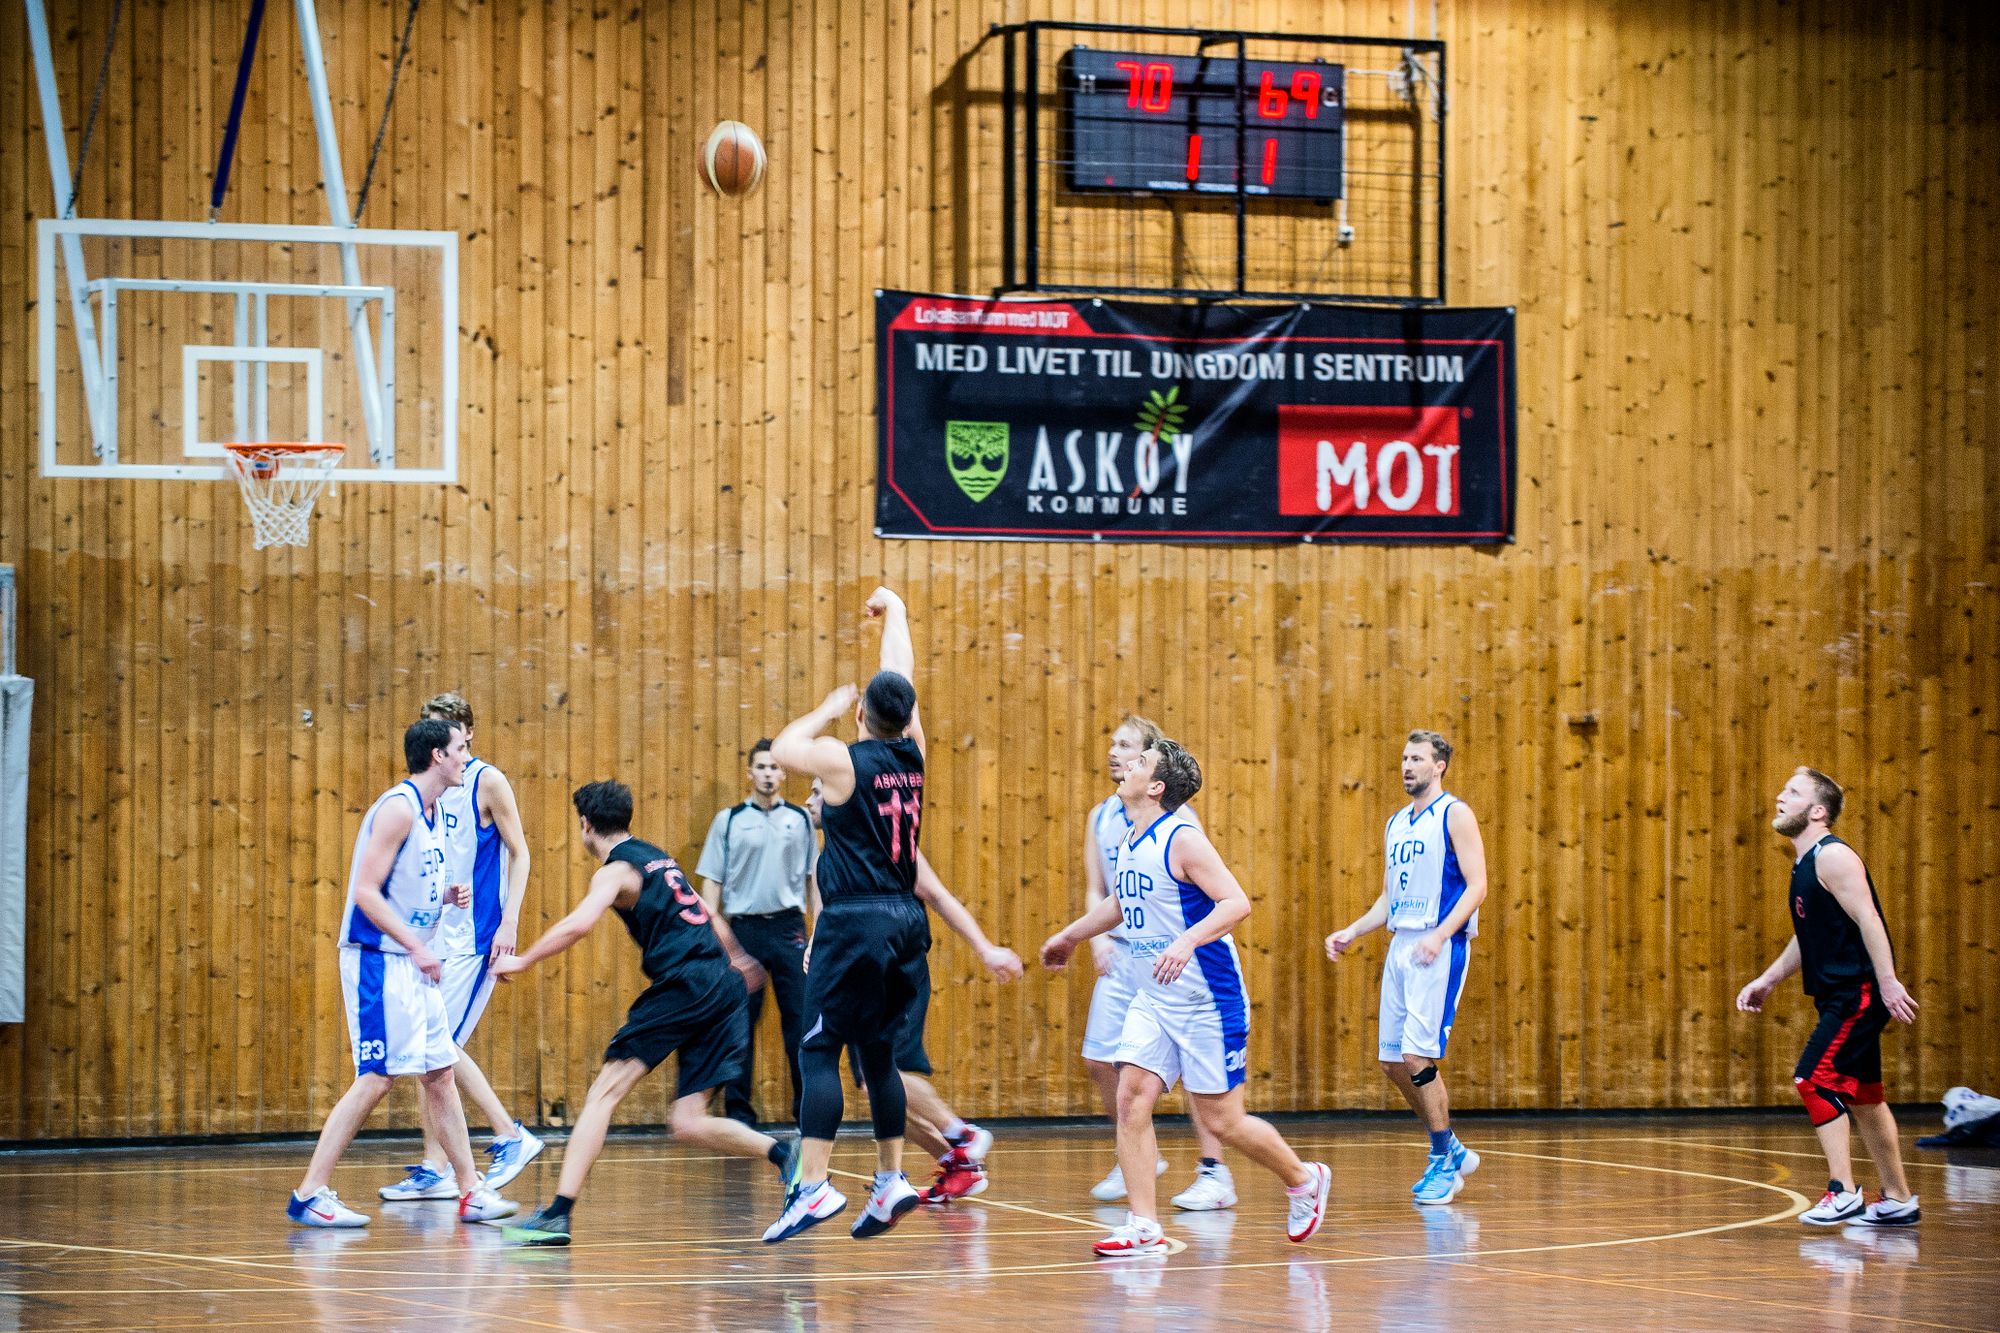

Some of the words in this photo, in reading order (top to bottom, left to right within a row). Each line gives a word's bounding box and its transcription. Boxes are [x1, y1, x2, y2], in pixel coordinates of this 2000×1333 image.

[1115, 61, 1173, 113] 70
[1258, 71, 1321, 119] 69
[915, 343, 987, 372] MED
[997, 345, 1085, 375] LIVET
[1092, 349, 1142, 377] TIL
[1151, 350, 1285, 380] UNGDOM
[1294, 354, 1304, 380] I
[1313, 353, 1464, 383] SENTRUM
[1316, 439, 1460, 514] MOT
[1027, 495, 1188, 515] KOMMUNE
[1124, 906, 1145, 930] 30
[360, 1038, 386, 1061] 23
